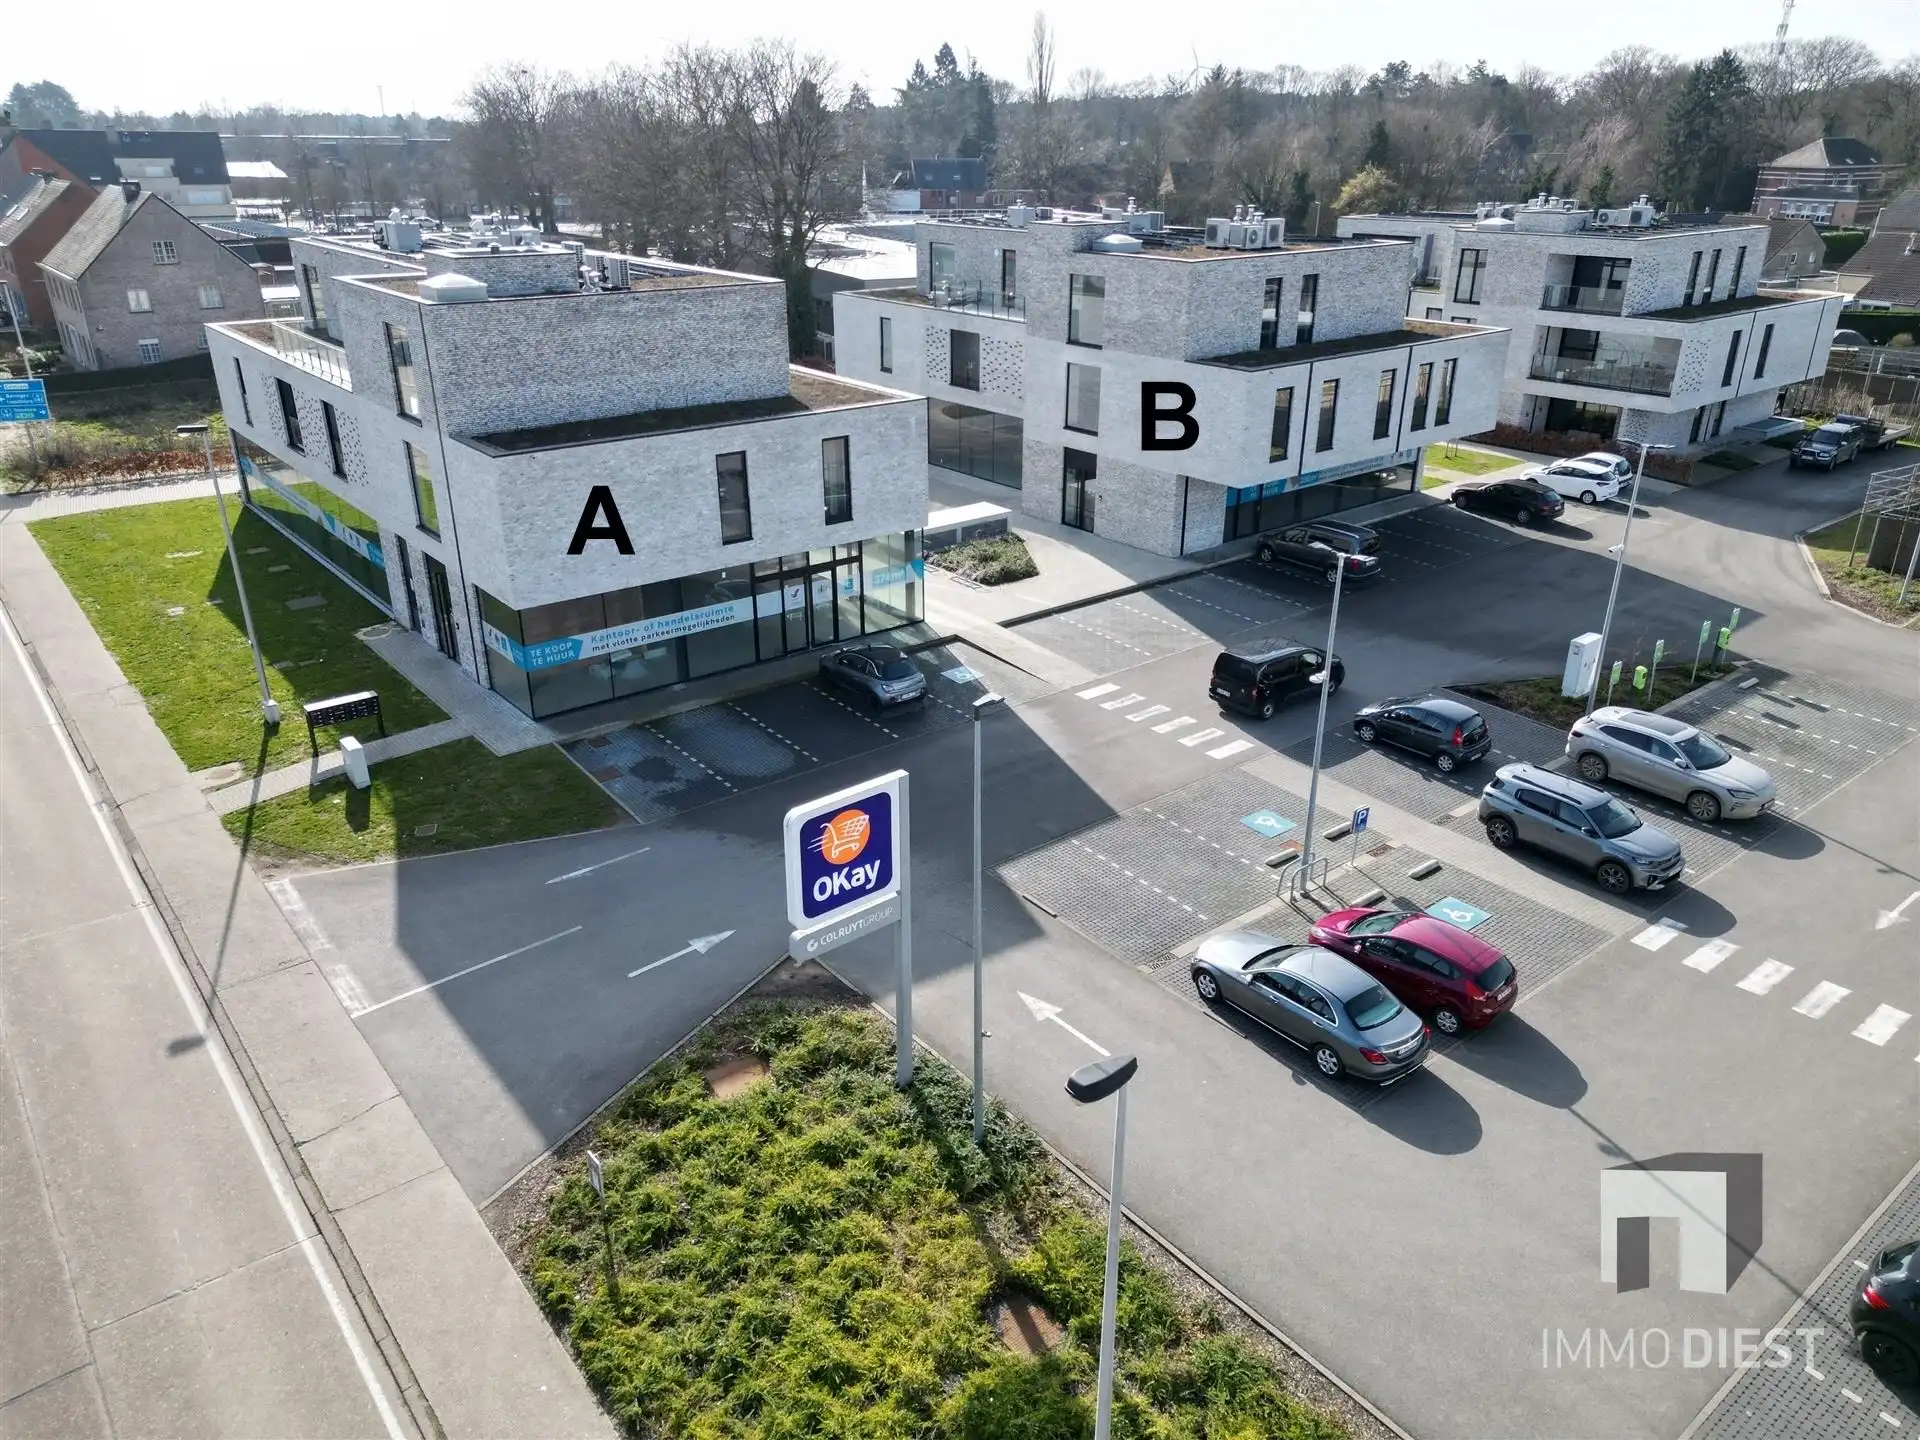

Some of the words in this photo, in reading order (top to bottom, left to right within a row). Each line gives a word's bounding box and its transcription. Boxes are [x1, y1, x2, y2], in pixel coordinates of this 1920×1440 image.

[590, 627, 641, 644] Kantoor-
[644, 623, 655, 632] of
[657, 605, 735, 629] handelsruimte
[592, 642, 610, 652] met
[612, 636, 639, 648] vlotte
[641, 614, 736, 642] parkeermogelijkheden
[530, 648, 543, 658] TE
[545, 641, 573, 654] KOOP
[531, 657, 545, 666] TE
[546, 650, 576, 663] HUUR
[1357, 810, 1367, 824] P
